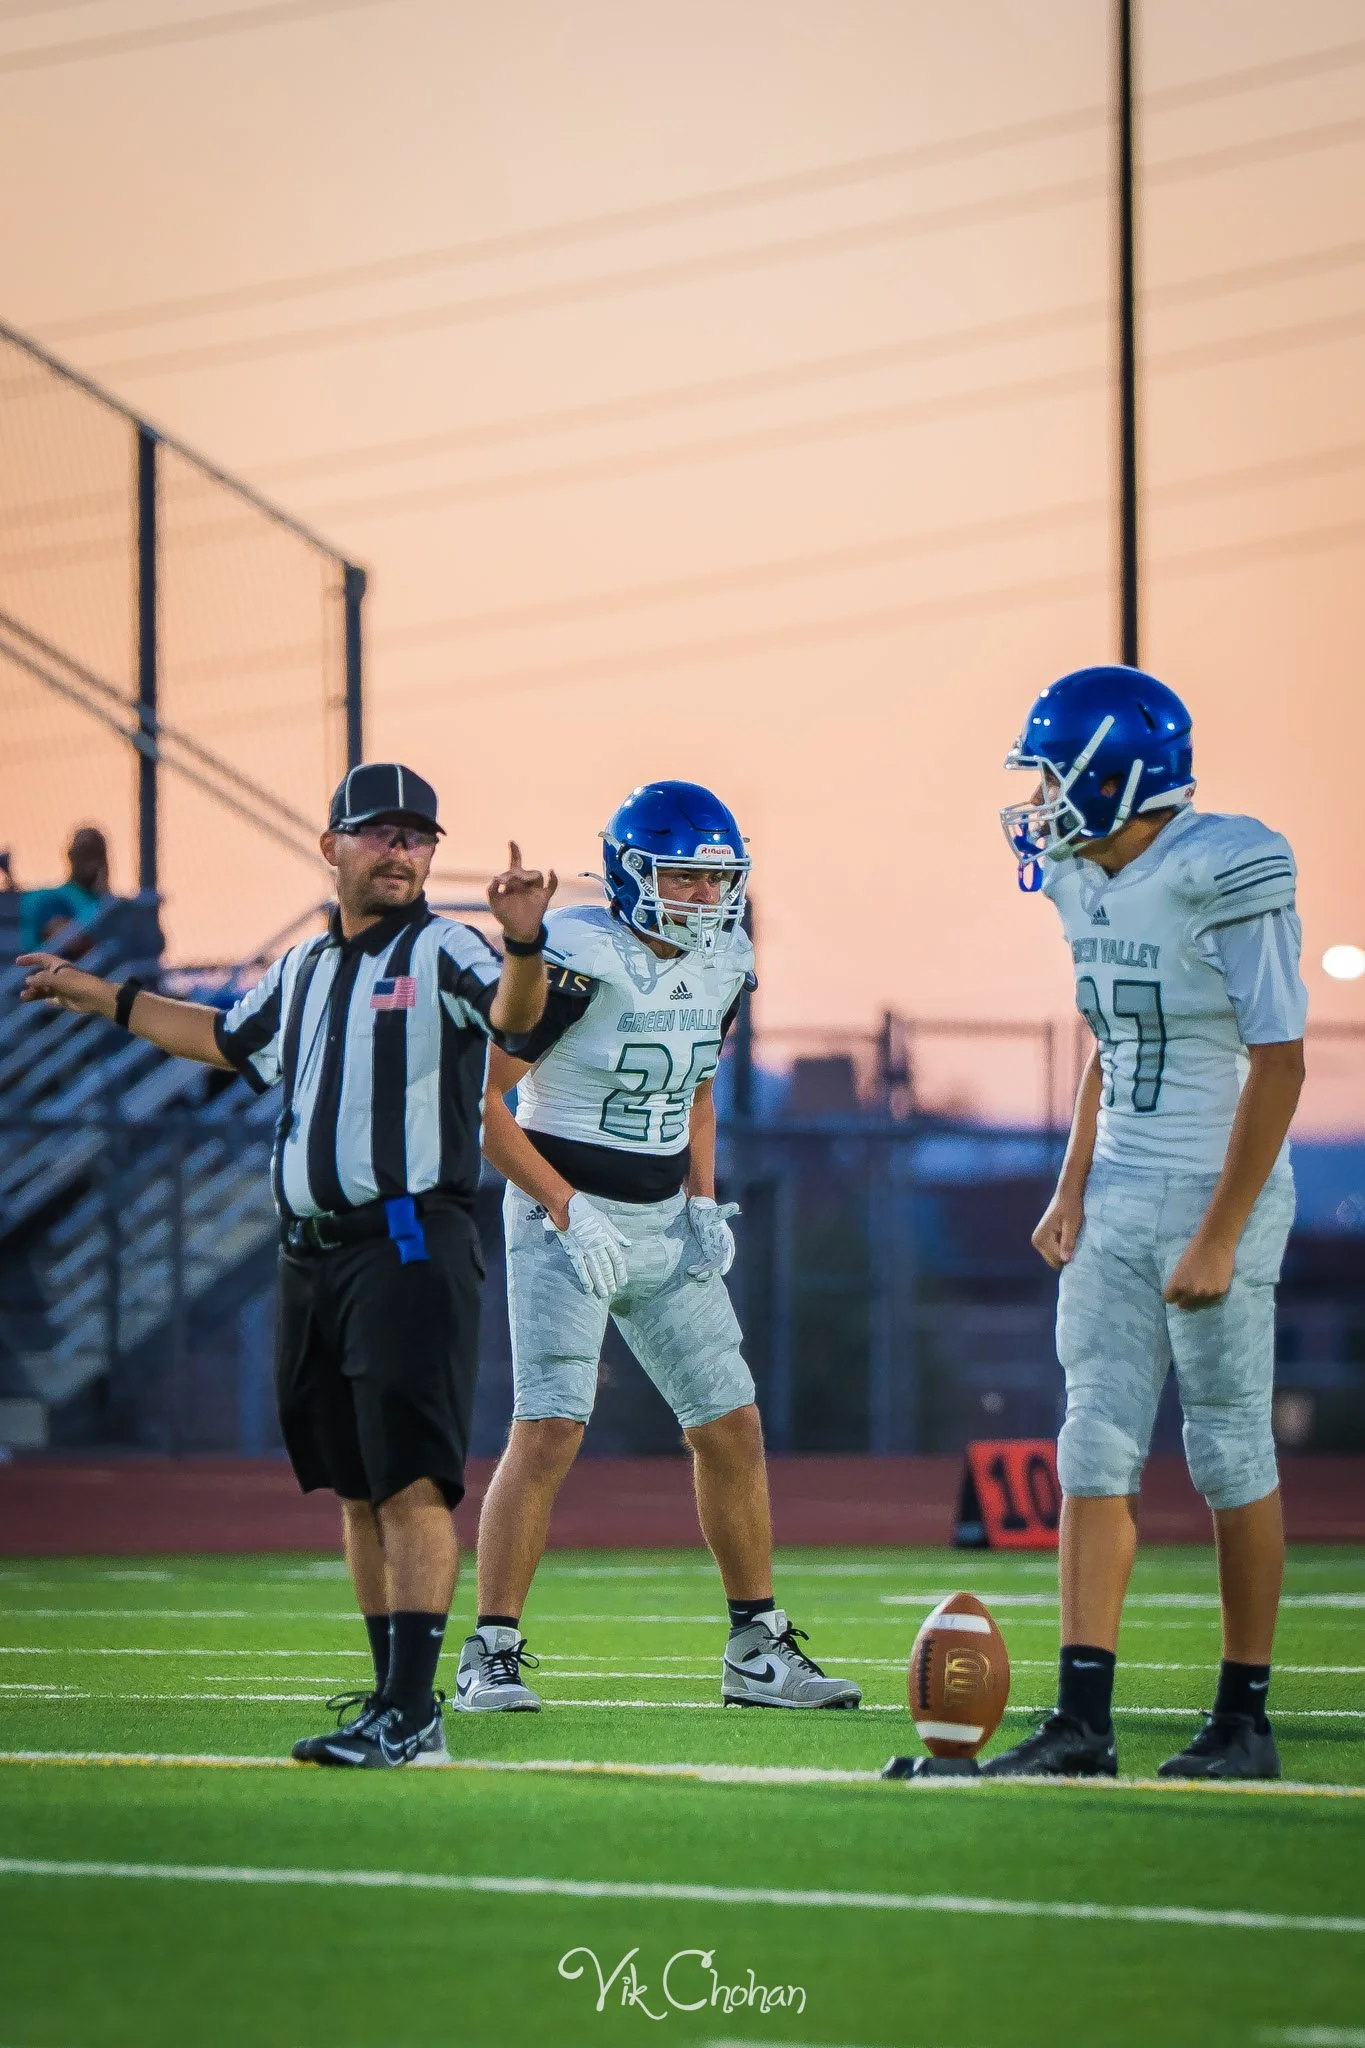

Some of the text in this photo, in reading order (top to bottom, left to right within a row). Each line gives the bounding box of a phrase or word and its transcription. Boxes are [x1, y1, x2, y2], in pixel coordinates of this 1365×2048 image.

[1100, 938, 1161, 969] VALLEY
[669, 991, 693, 1001] adidas
[616, 1009, 676, 1033] GREEN
[598, 1039, 722, 1143] 25
[990, 1453, 1060, 1530] 10
